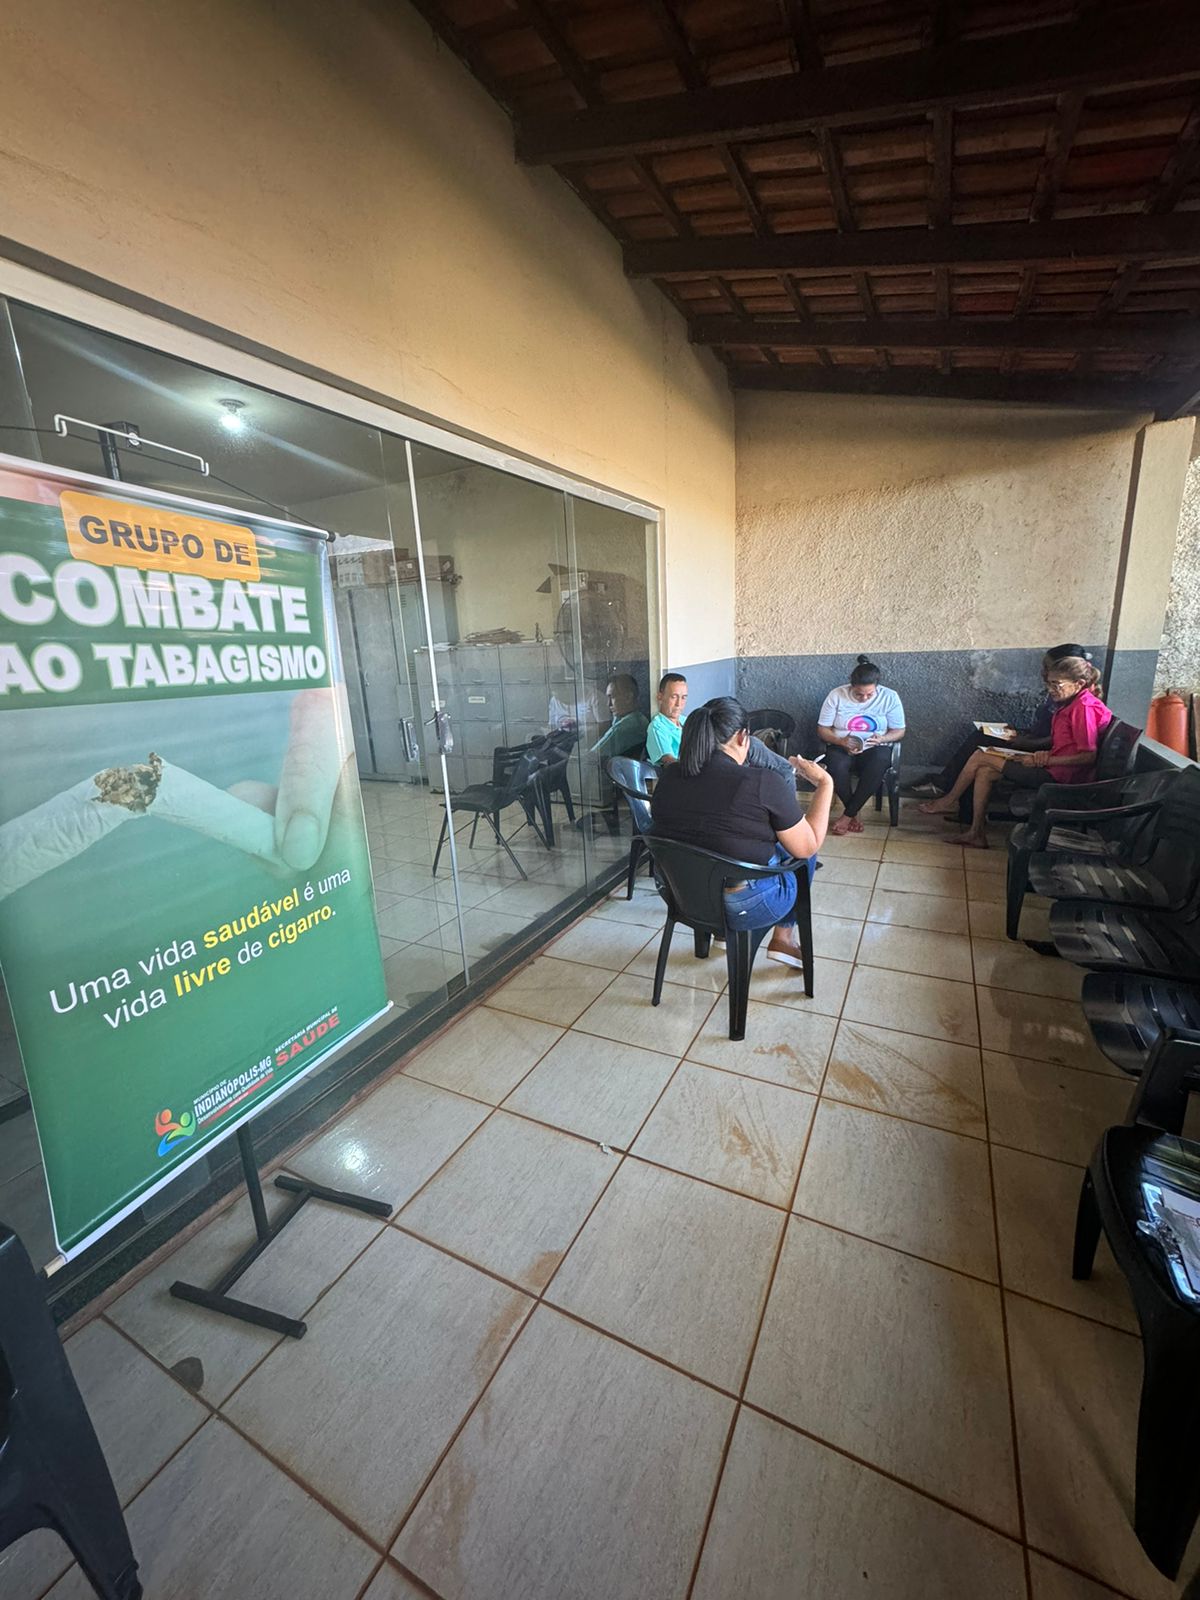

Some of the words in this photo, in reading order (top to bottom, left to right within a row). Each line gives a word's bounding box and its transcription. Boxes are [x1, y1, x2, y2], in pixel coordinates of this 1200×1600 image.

[78, 514, 205, 560] GRUPO
[215, 537, 252, 567] DE
[0, 552, 311, 635] COMBATE
[0, 641, 83, 694] AO
[92, 643, 327, 690] TABAGISMO
[49, 967, 132, 1014] Uma
[138, 939, 197, 976] vida
[203, 887, 300, 949] saudável
[303, 881, 315, 902] é
[318, 868, 351, 895] uma
[103, 988, 167, 1029] vida
[173, 956, 231, 997] livre
[237, 941, 264, 966] de
[268, 905, 337, 949] cigarro.
[194, 1055, 272, 1118] INDIANÓPOLIS-MG
